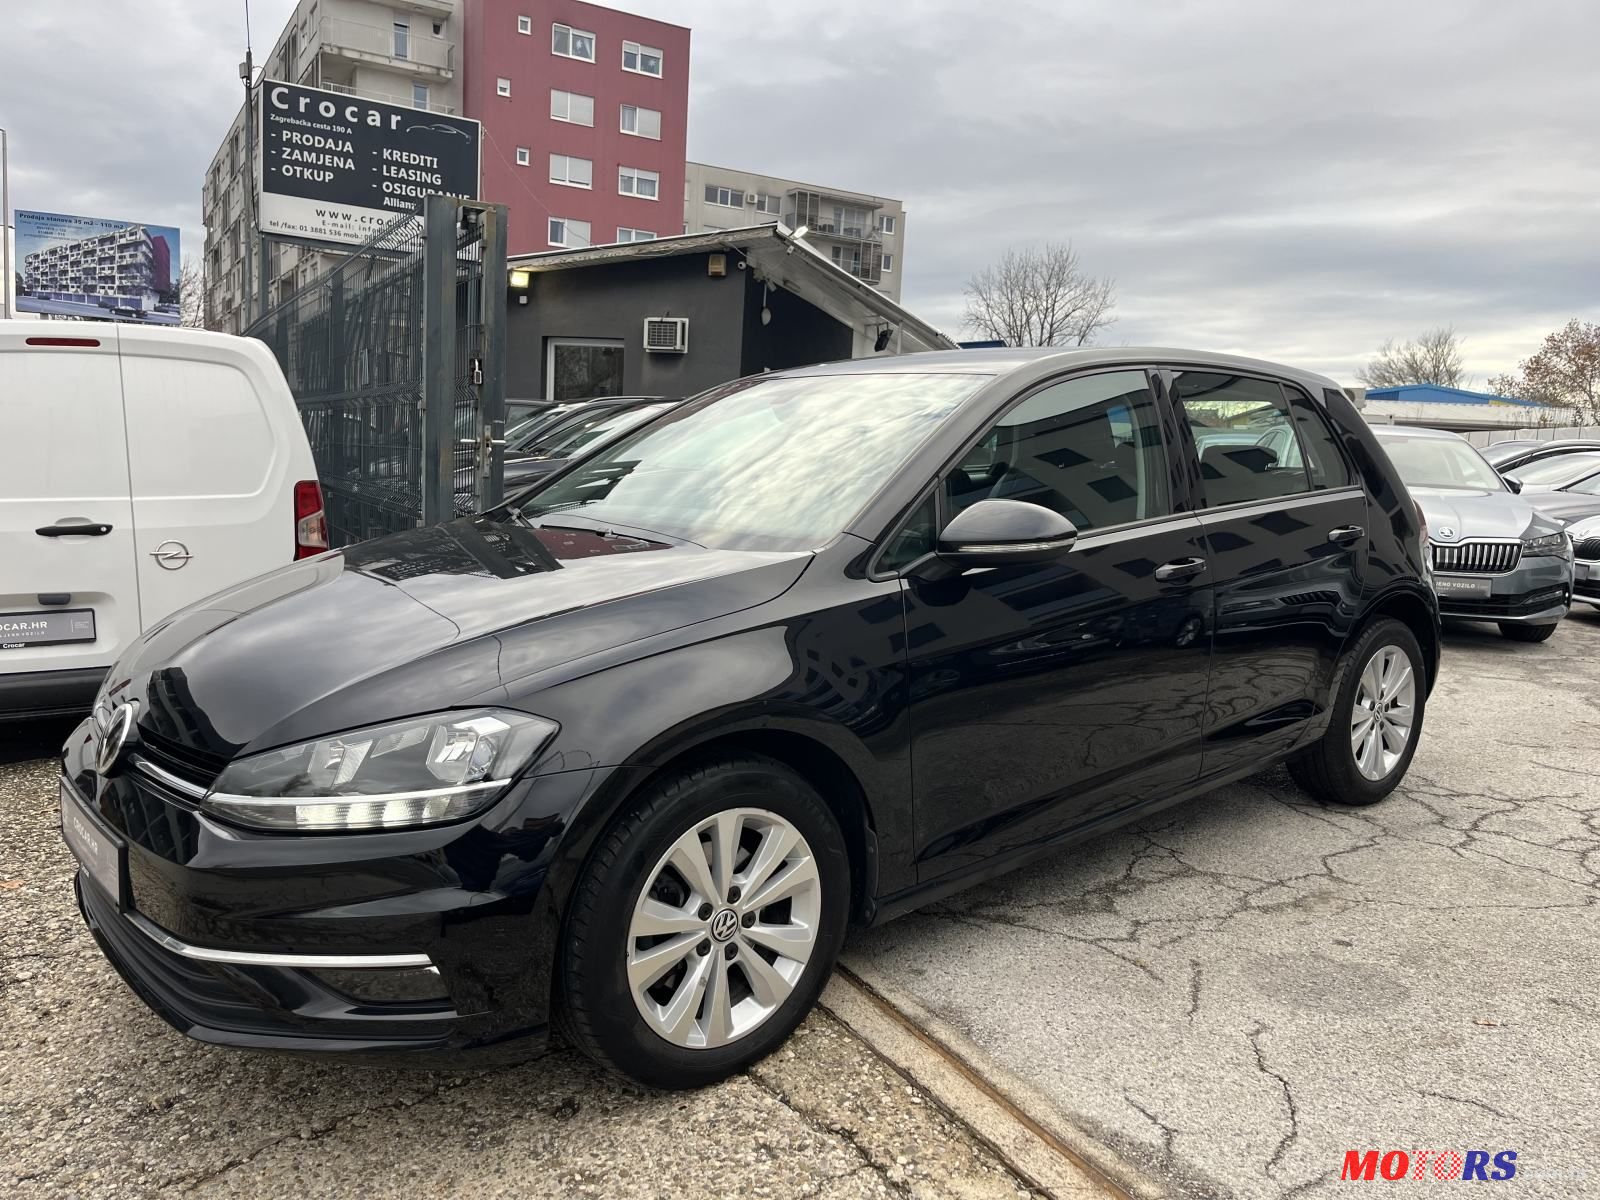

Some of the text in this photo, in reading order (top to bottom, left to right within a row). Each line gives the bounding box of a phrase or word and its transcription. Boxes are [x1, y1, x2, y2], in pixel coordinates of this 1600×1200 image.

[270, 86, 402, 130] Crocar
[312, 122, 331, 131] cesta
[332, 125, 345, 133] 190
[282, 130, 354, 153] PRODAJA
[282, 147, 355, 171] ZAMJENA
[383, 148, 438, 169] KREDITI
[282, 164, 334, 183] OTKUP
[383, 164, 442, 185] LEASING
